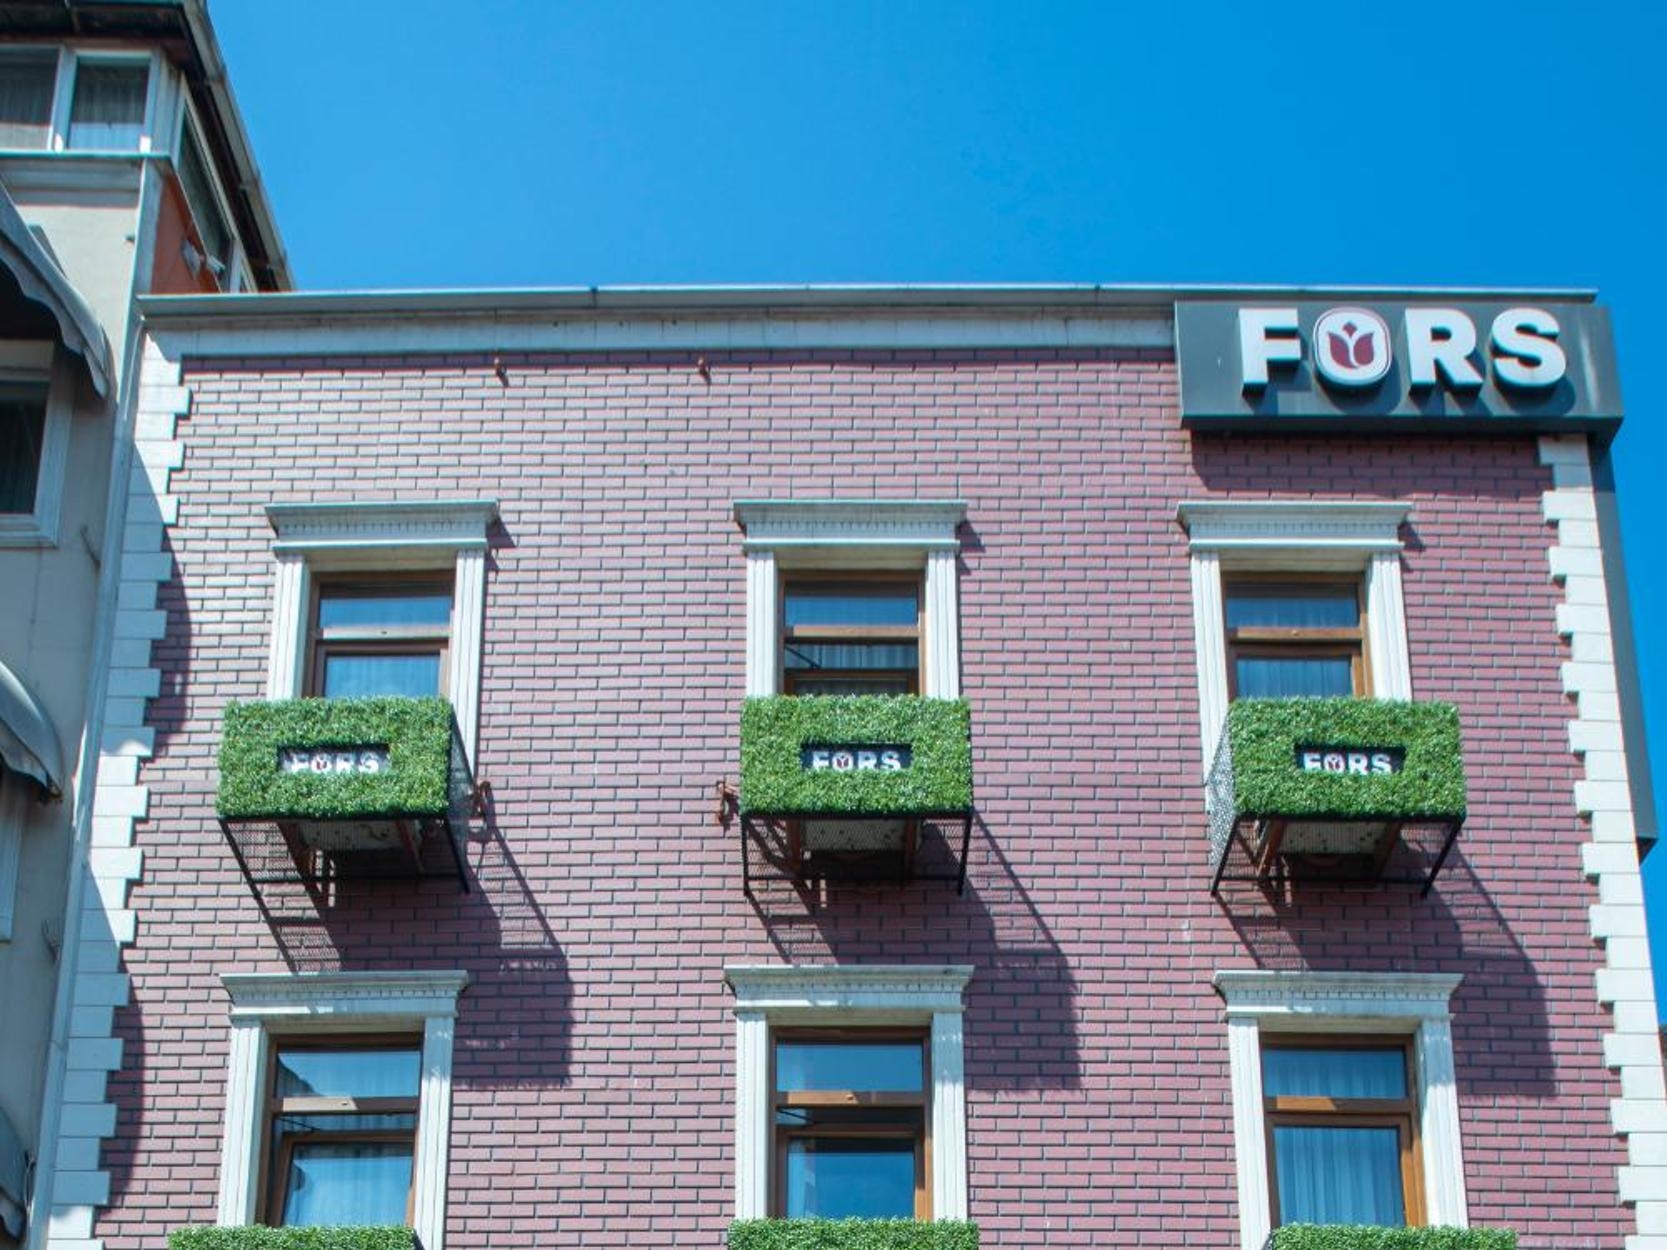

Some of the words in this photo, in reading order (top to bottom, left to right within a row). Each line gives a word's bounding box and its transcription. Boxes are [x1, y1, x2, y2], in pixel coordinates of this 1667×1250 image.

[1238, 307, 1567, 391] FORS
[289, 751, 381, 773] FORS
[811, 751, 902, 773] FORS
[1303, 752, 1393, 774] FORS
